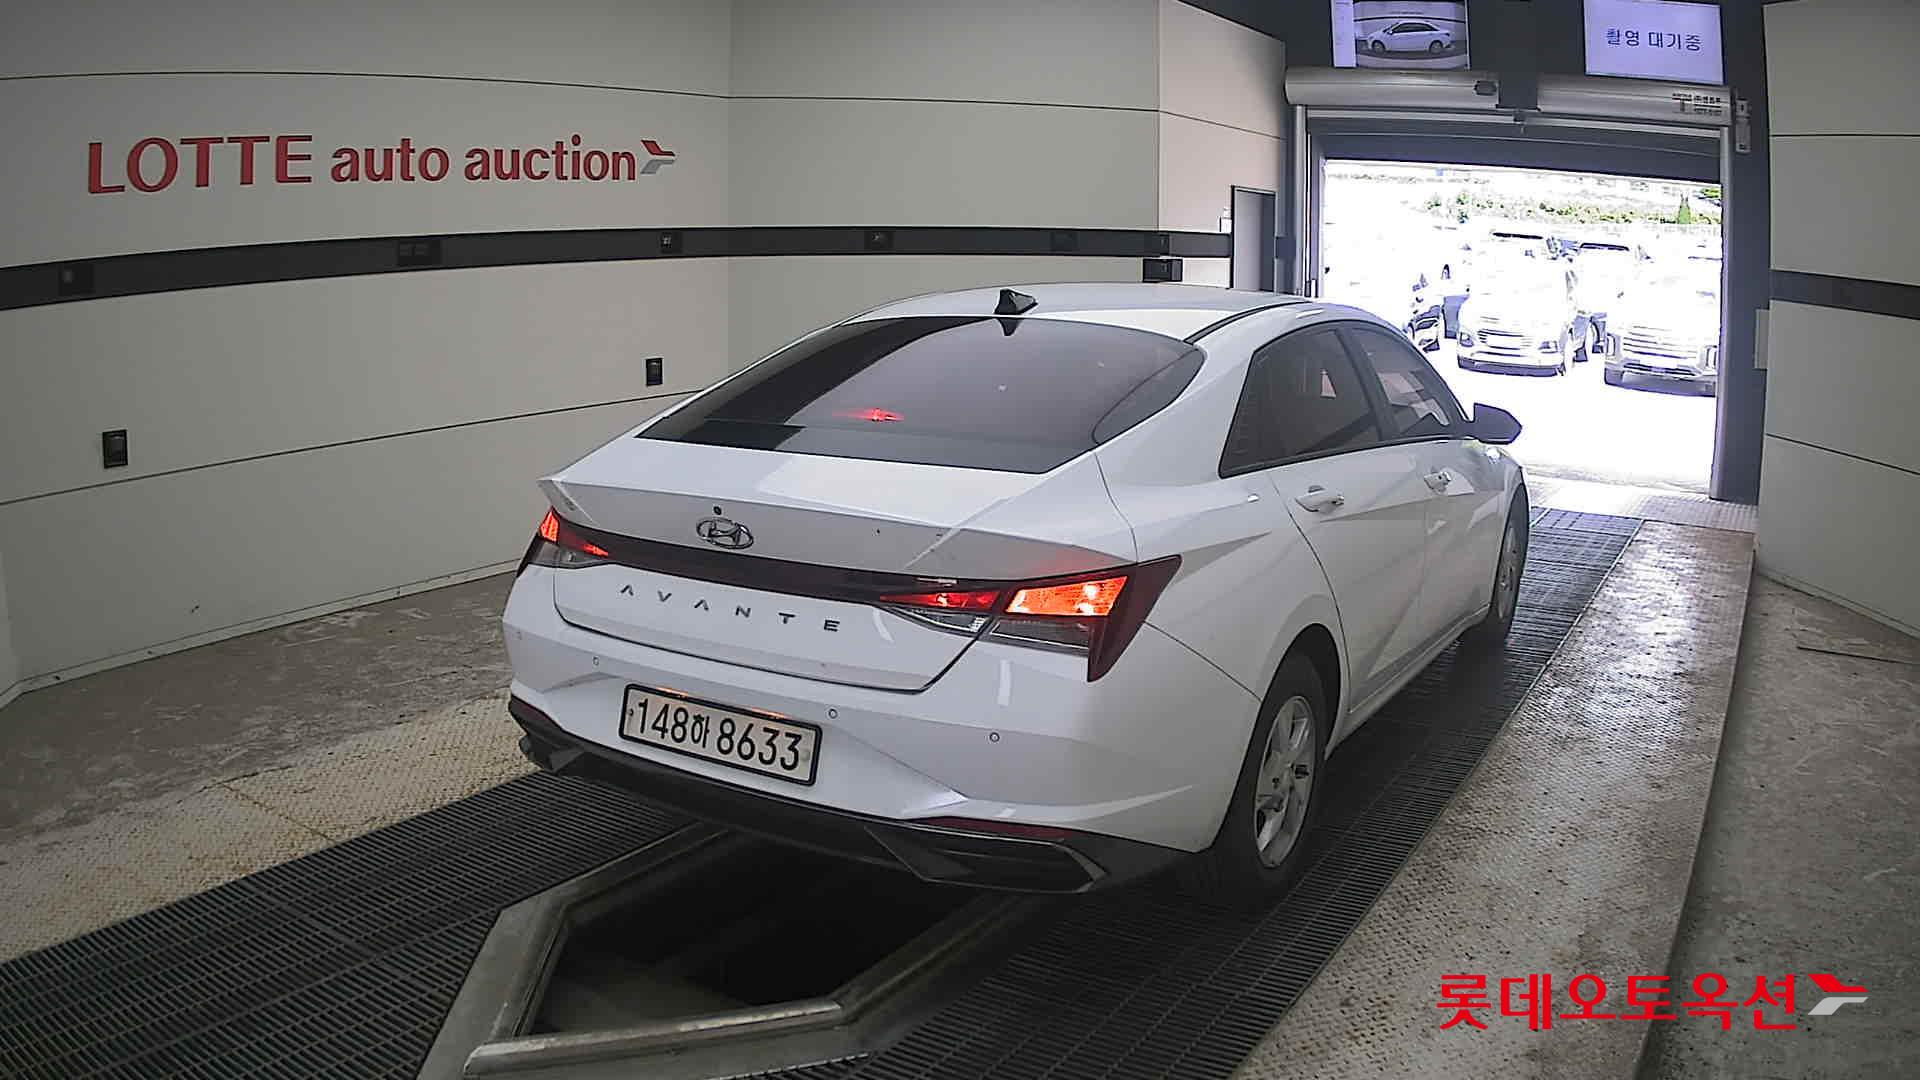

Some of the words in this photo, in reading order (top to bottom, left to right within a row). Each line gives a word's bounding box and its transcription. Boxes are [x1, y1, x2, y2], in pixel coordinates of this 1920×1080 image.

[1648, 31, 1701, 52] 대기중
[88, 135, 312, 194] LOTTE
[330, 138, 449, 182] auto
[464, 134, 636, 181] auction
[620, 584, 841, 632] AVANTE
[638, 698, 710, 749] 148하
[716, 717, 802, 771] 8633
